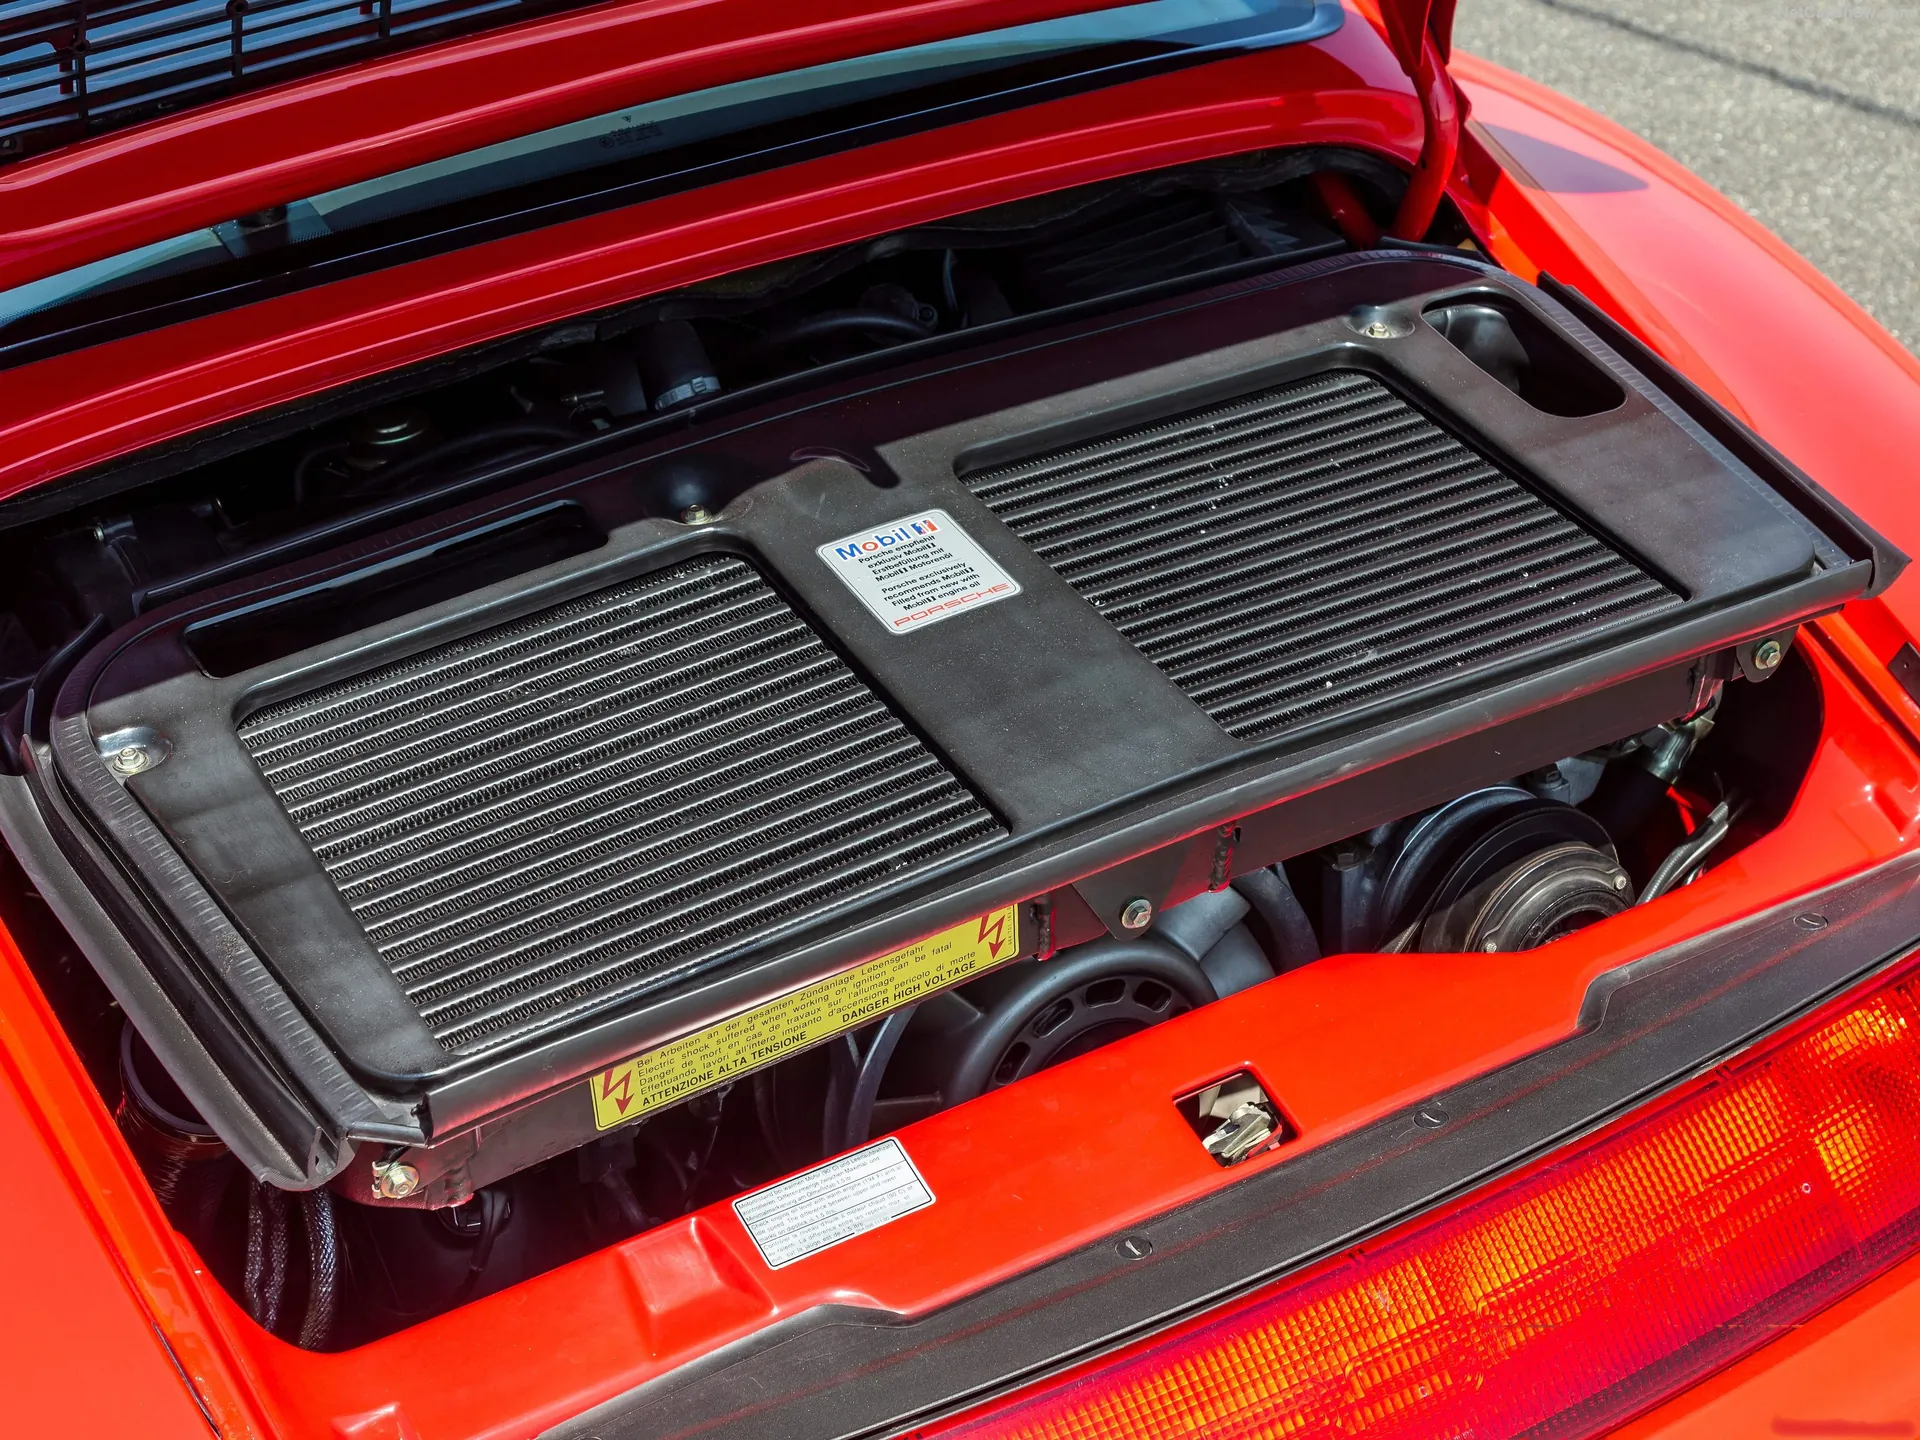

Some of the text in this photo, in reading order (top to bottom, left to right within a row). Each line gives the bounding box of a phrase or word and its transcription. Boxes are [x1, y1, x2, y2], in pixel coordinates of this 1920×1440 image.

[833, 526, 912, 561] Mobil
[857, 534, 936, 563] Porsche empfiehlt
[866, 552, 903, 568] exklusiv
[871, 547, 945, 576] Erstbefüllung mit
[880, 560, 968, 593] Porsche exclusively
[908, 551, 954, 571] Motorenöl
[882, 578, 942, 601] recommends
[891, 572, 980, 606] Filled from new with
[893, 582, 1010, 627] PORSCHE
[936, 585, 969, 599] engine
[967, 580, 981, 588] oil
[637, 943, 924, 1068] Bei Arbeiten an der gesamten Zündanlage Lebensgefahr
[638, 941, 951, 1077] Electric shock suffered when working on ignition can be fatal
[640, 950, 975, 1095] Effettuando lavori all'intero impianto d'accensione pericolo di morte
[639, 974, 895, 1087] Danger de mort en cas de travaux sur l'allumage
[641, 959, 976, 1106] ATTENZIONE ALTA TENSIONE DANGER HIGH VOLTAGE
